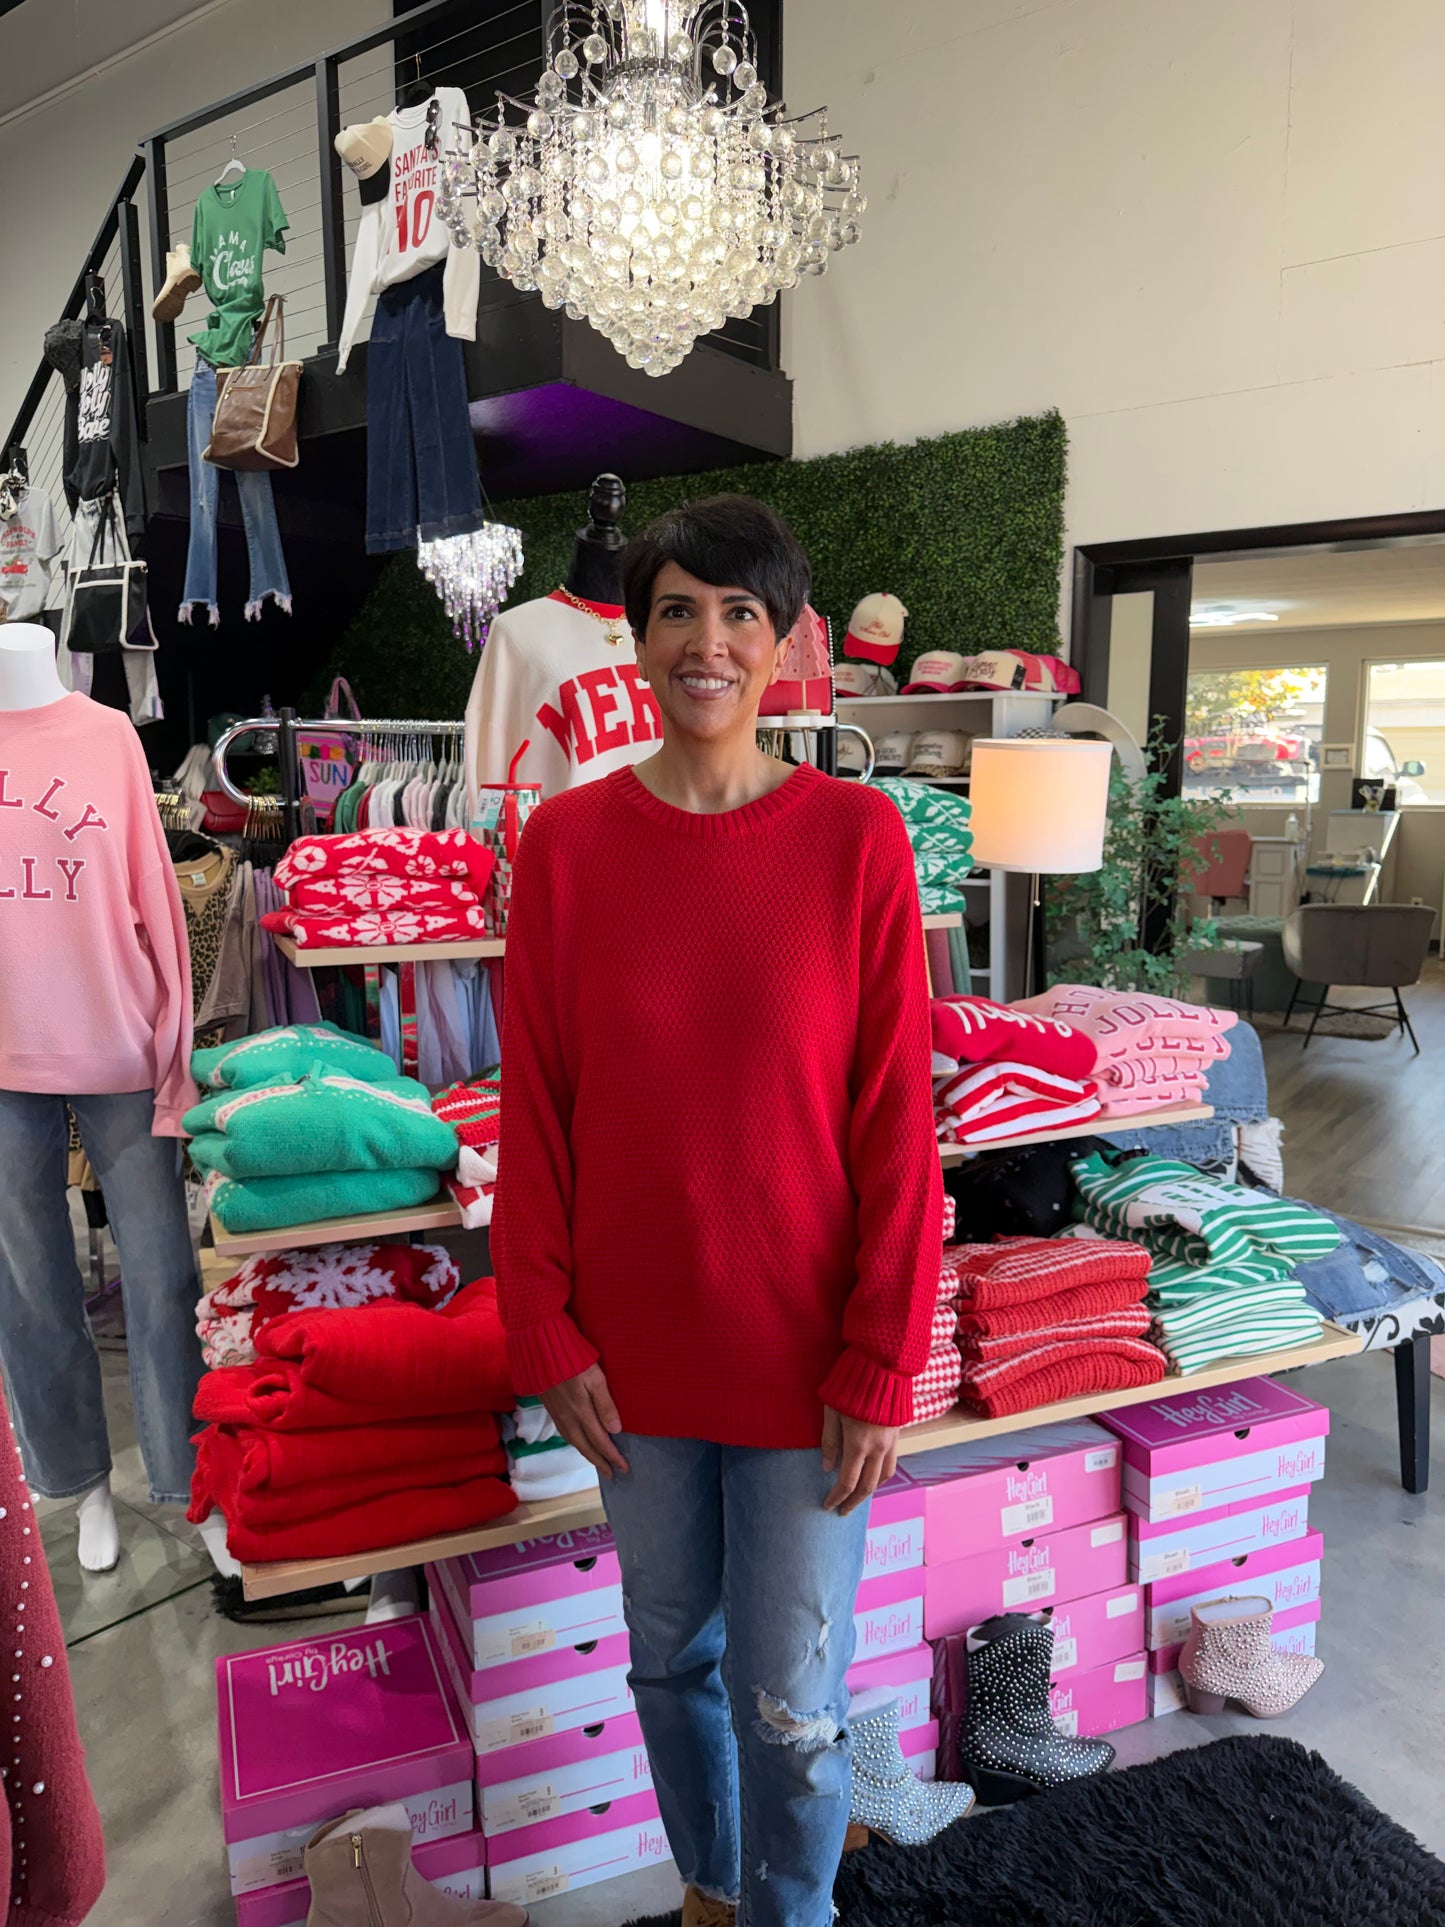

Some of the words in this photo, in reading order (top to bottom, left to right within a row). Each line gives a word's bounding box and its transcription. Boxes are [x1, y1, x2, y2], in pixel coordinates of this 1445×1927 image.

[310, 761, 348, 786] SUN
[405, 1798, 457, 1834] eyGirl
[638, 1832, 669, 1857] Hey
